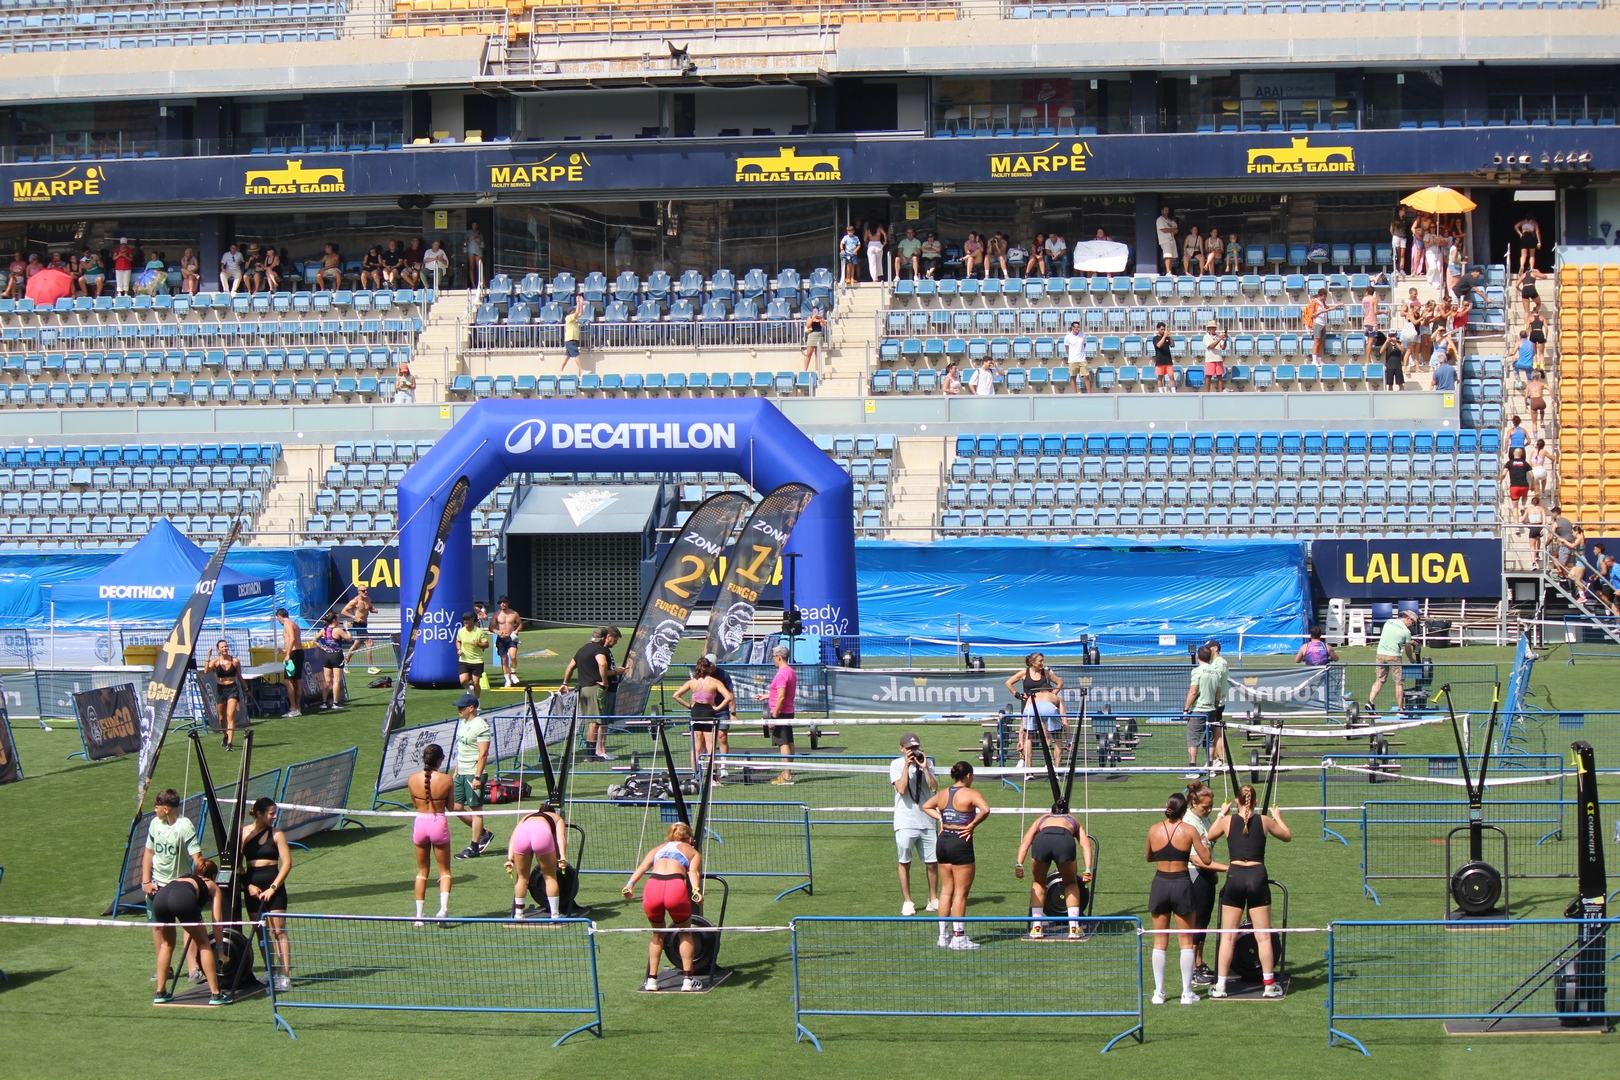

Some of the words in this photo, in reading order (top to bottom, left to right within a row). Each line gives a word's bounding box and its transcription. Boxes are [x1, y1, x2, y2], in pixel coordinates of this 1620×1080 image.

[735, 172, 790, 182] FINCAS
[793, 171, 841, 181] GADIR
[1247, 163, 1303, 173] FINCAS
[1306, 162, 1355, 172] GADIR
[245, 184, 297, 194] FINCAS
[300, 183, 346, 193] GADIR
[551, 423, 736, 449] DECATHLON
[752, 520, 789, 544] ZONA
[684, 531, 721, 557] ZONA
[736, 544, 772, 583] 1
[1345, 552, 1470, 583] LALIGA
[664, 555, 705, 599] 2
[99, 585, 174, 600] DECATHLON
[238, 581, 261, 597] DECATHLON
[406, 608, 455, 627] Rady
[794, 603, 840, 622] eady
[1587, 815, 1596, 854] concept
